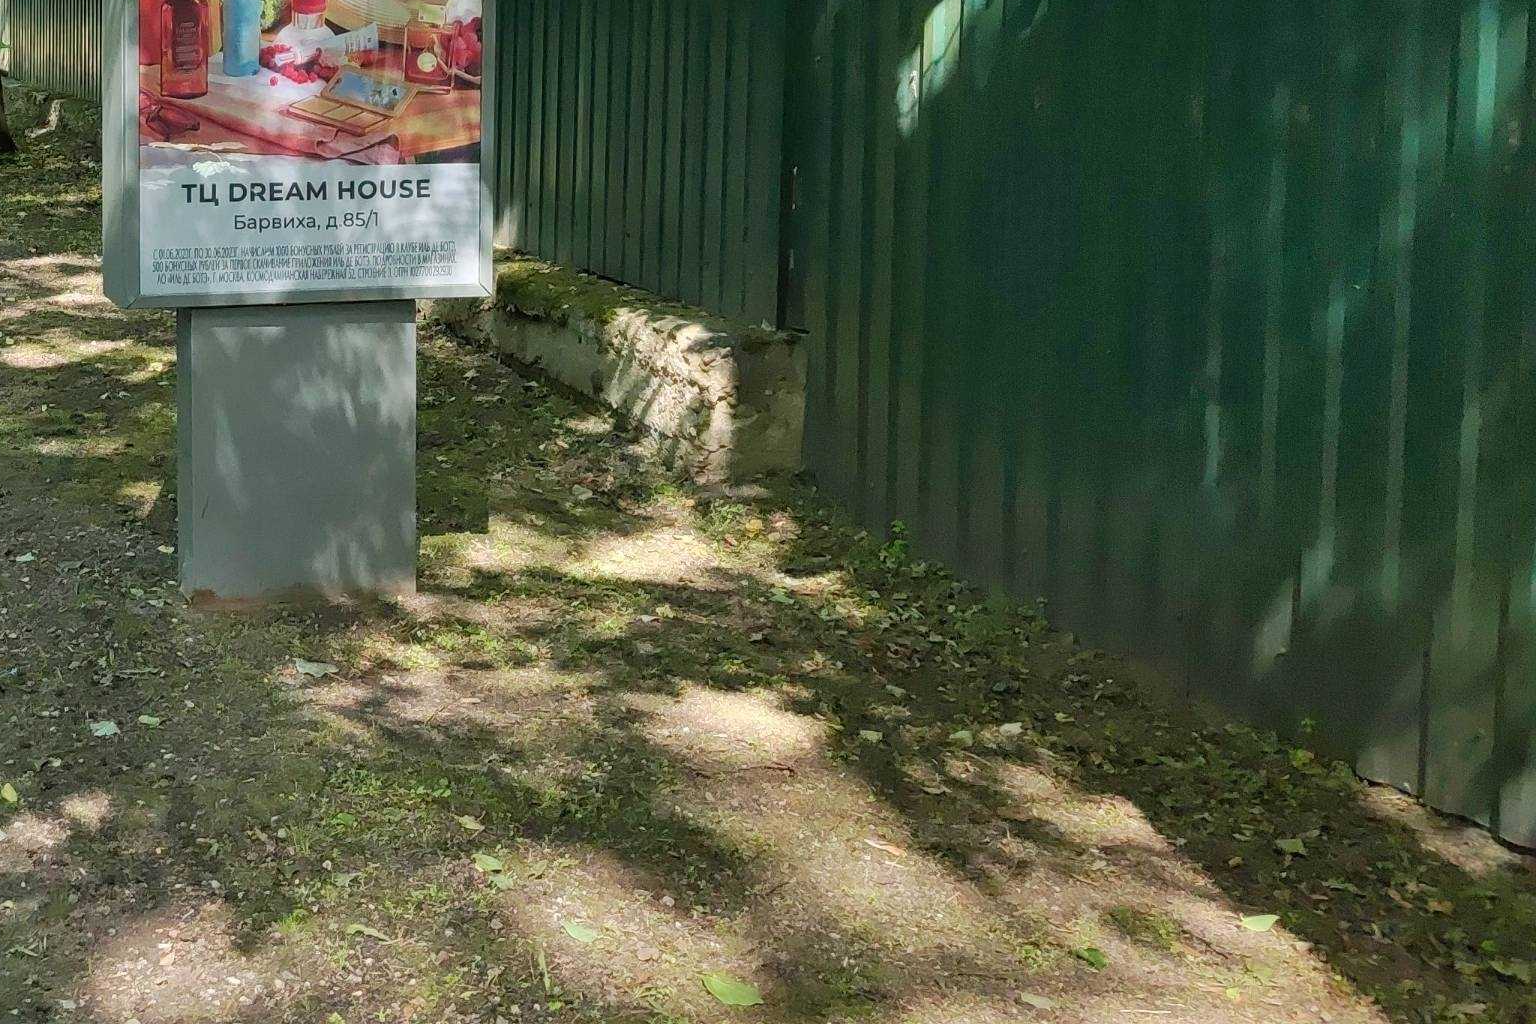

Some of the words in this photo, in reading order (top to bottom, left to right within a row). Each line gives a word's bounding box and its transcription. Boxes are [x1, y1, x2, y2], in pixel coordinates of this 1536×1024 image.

[181, 183, 219, 206] ТЦ
[229, 181, 327, 203] DREAM
[338, 179, 431, 199] HOUSE
[234, 213, 321, 234] Барвиха,
